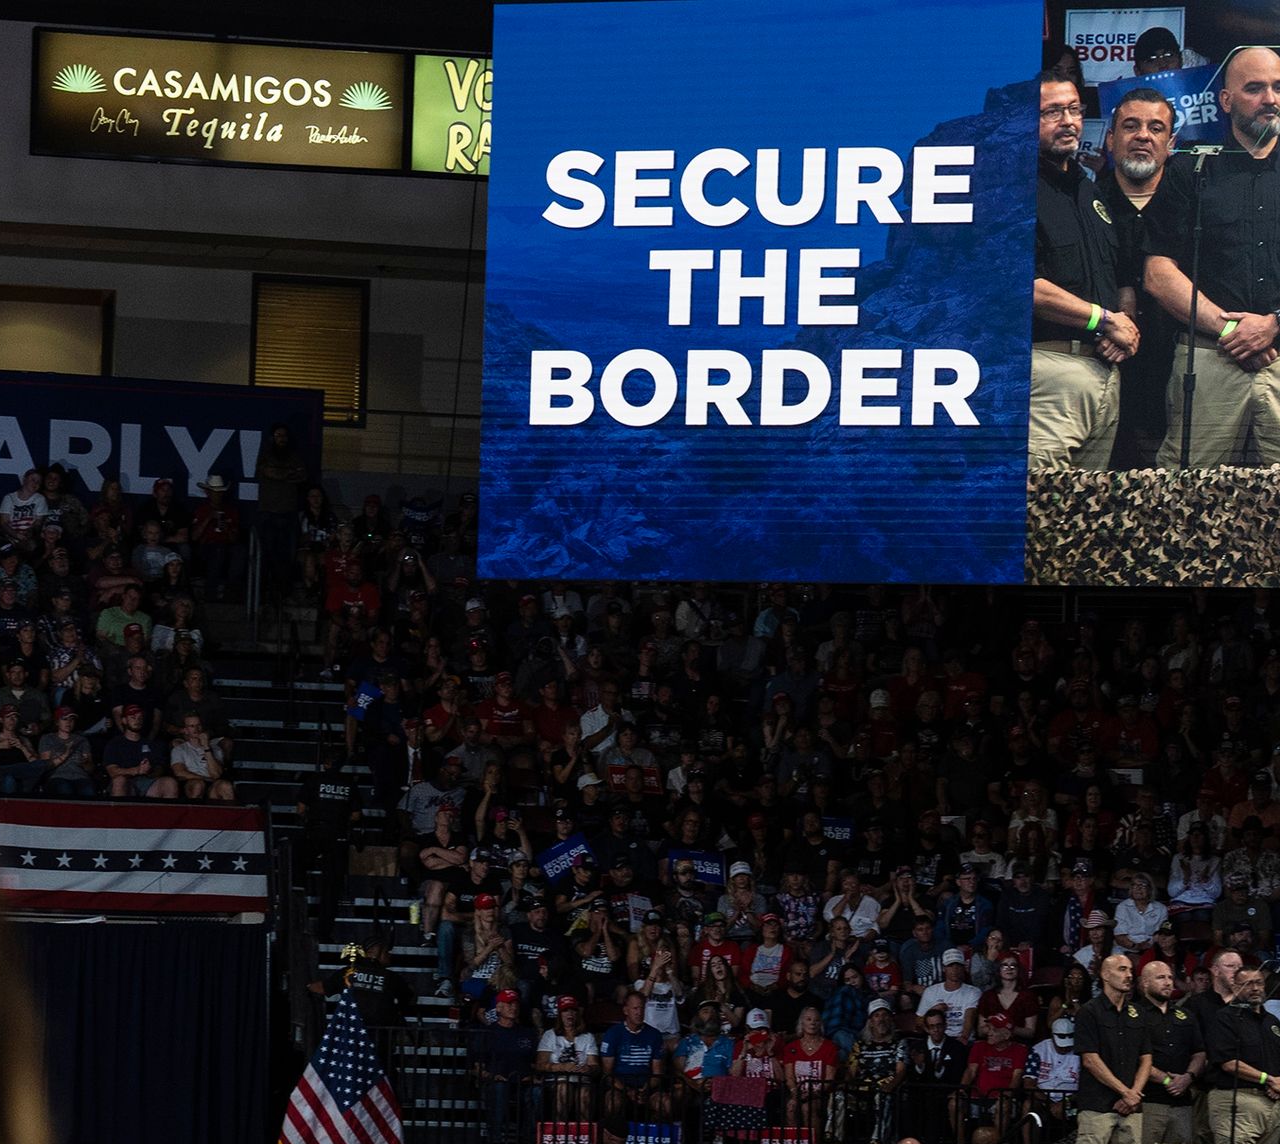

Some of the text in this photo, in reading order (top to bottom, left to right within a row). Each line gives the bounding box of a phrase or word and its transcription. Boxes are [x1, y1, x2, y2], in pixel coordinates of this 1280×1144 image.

[1075, 33, 1136, 45] SECURE
[113, 67, 332, 108] CASAMIGOS
[1180, 91, 1216, 107] OUR
[163, 107, 283, 149] Tequila
[542, 146, 975, 228] SECURE
[649, 248, 860, 326] THE
[529, 349, 980, 427] BORDER
[320, 783, 351, 796] POLICE
